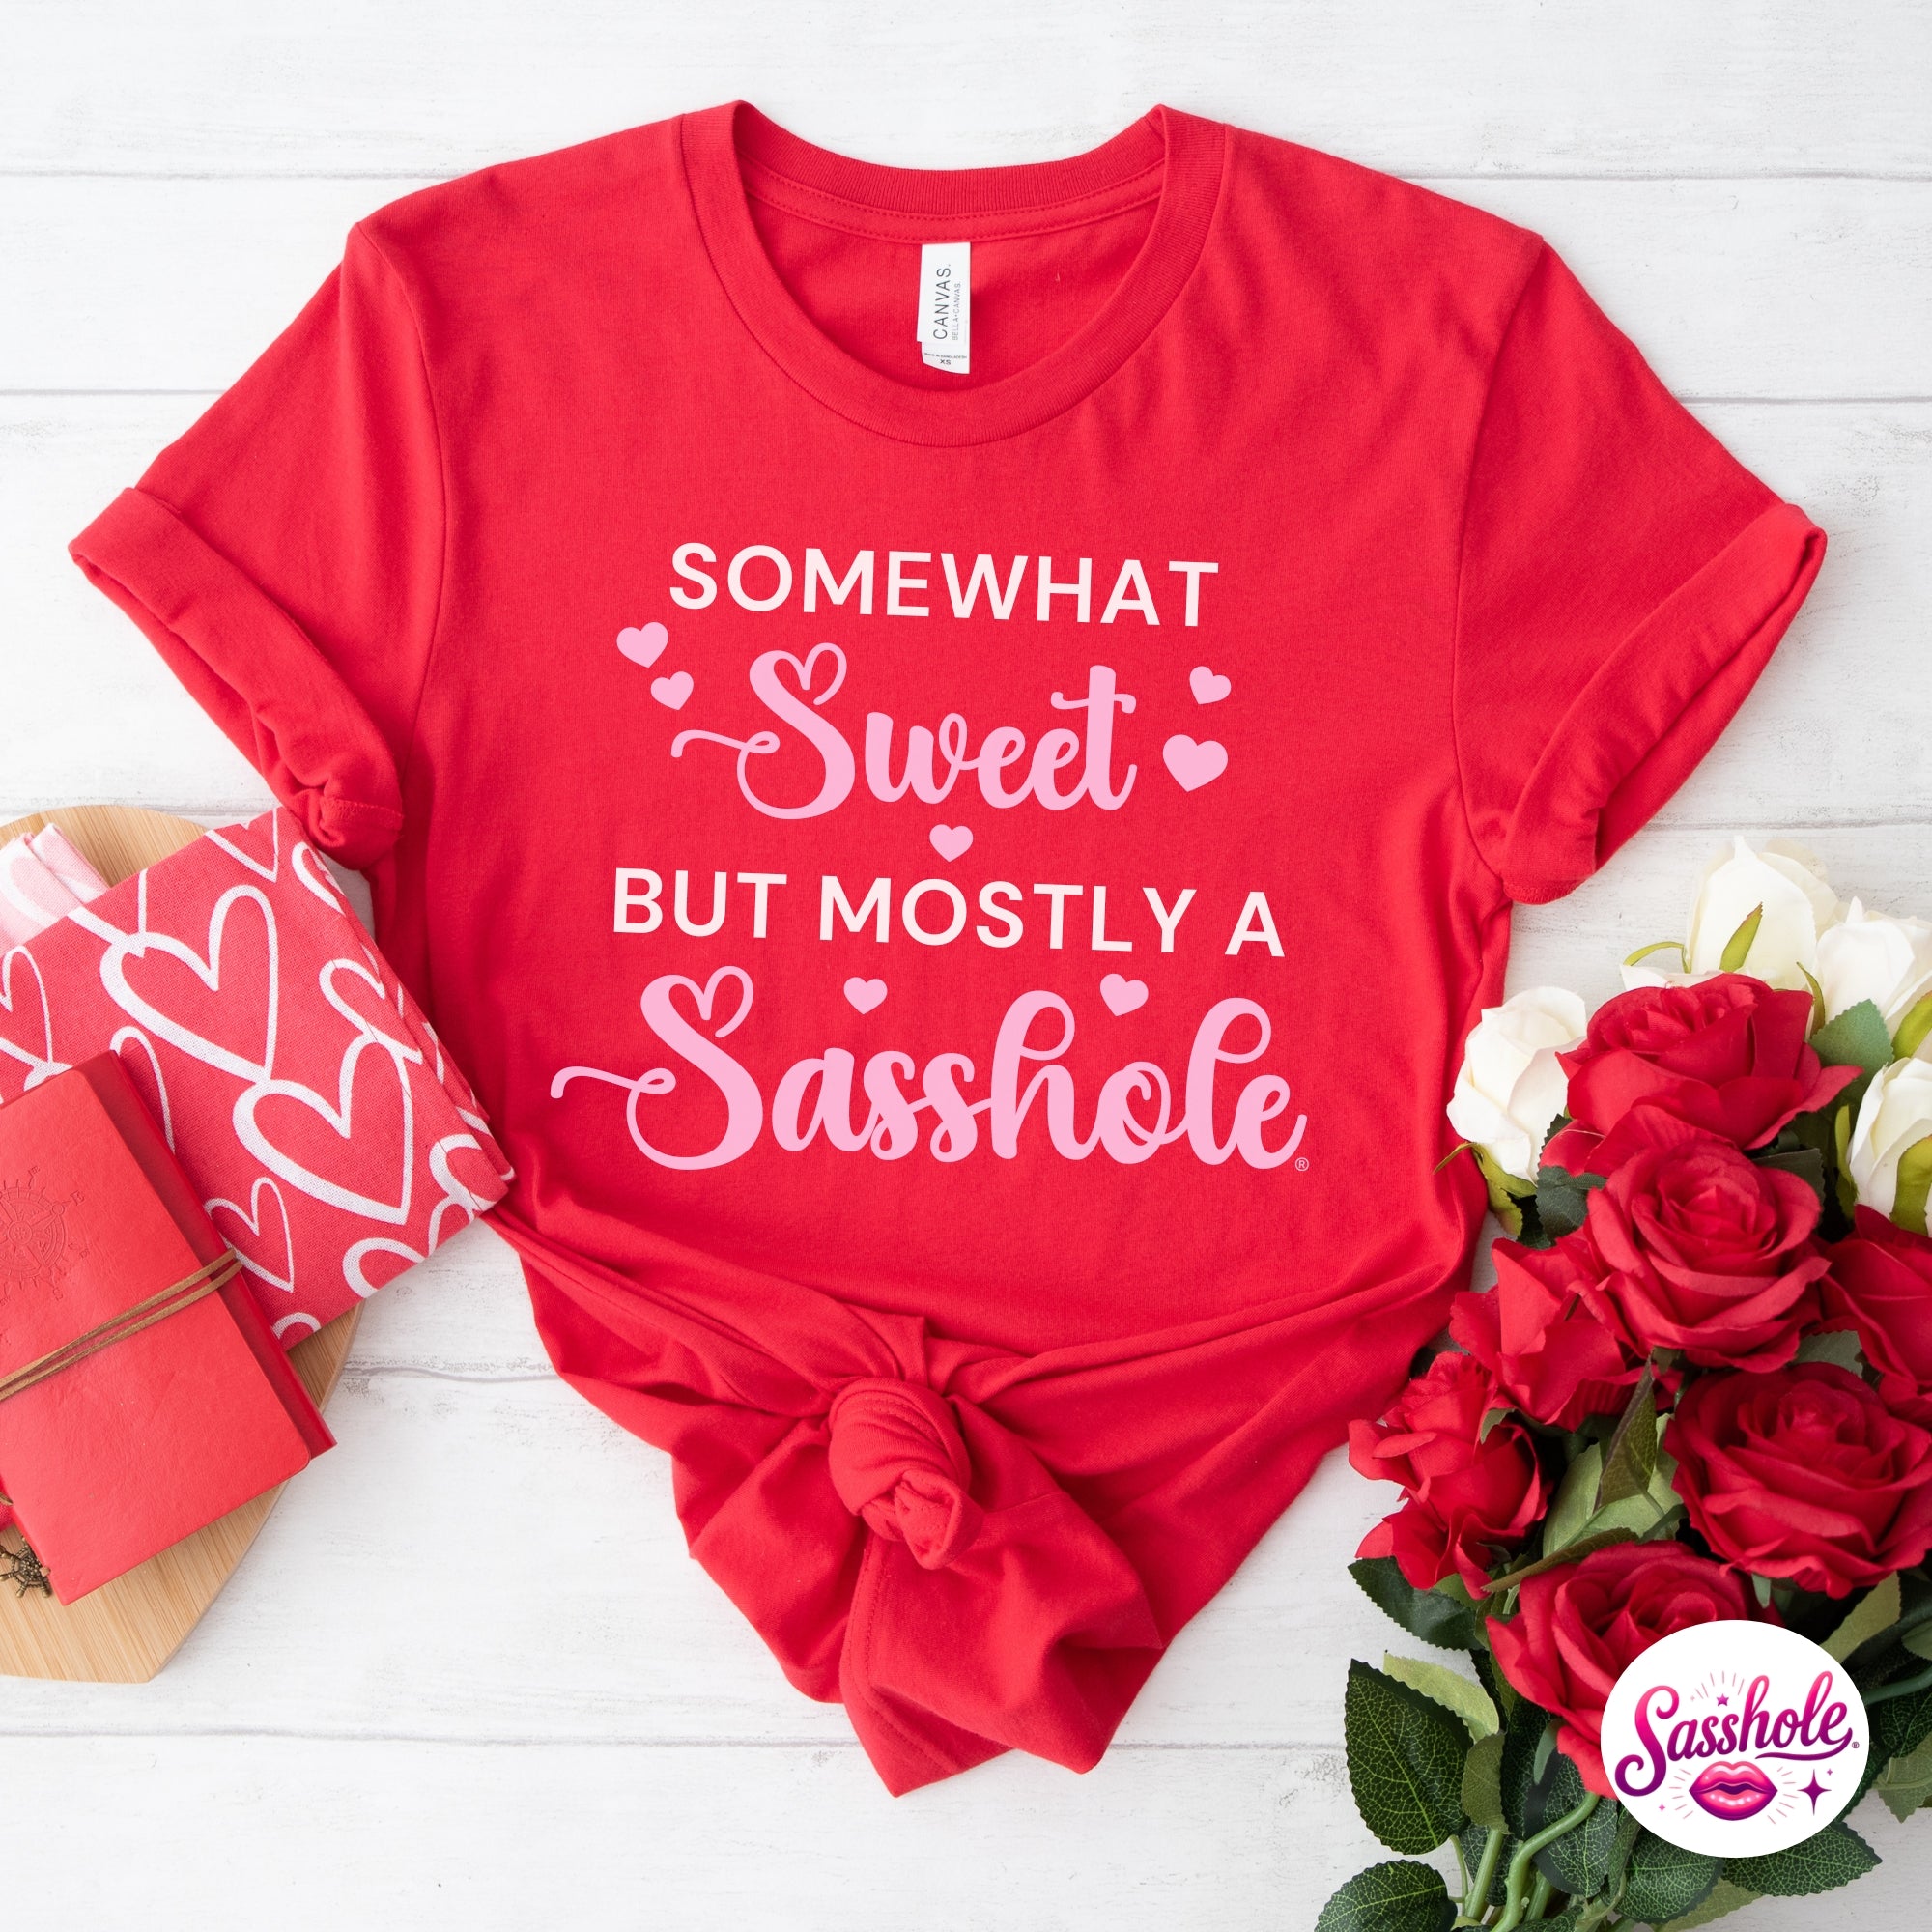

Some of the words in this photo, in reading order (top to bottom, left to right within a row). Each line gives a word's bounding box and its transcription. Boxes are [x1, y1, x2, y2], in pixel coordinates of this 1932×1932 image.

[670, 543, 1219, 627] SOMEWHAT
[671, 643, 1137, 819] Sweet
[613, 868, 787, 939] BUT
[820, 876, 1198, 953] MOSTLY
[1225, 892, 1286, 957] A
